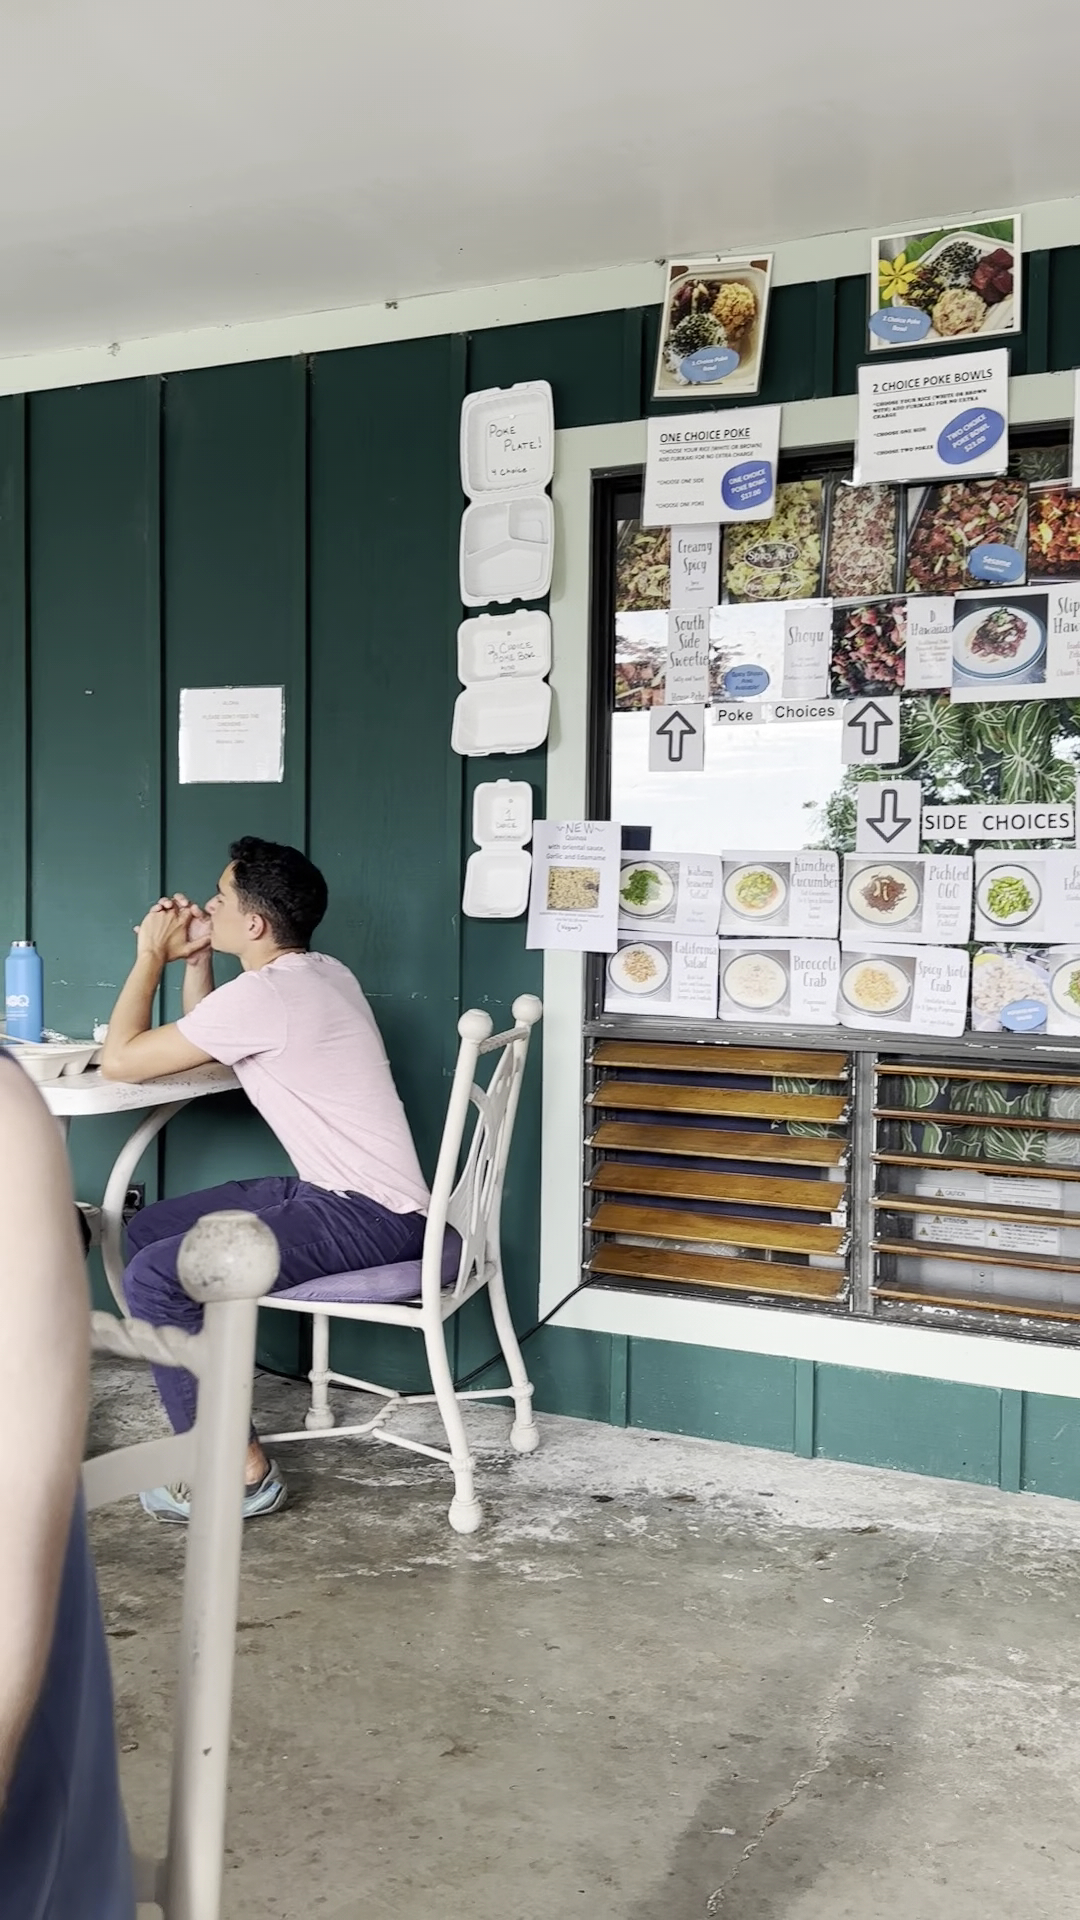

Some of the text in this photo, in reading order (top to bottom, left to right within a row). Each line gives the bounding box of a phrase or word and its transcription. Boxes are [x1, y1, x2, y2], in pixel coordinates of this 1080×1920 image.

[872, 368, 993, 393] 2 CHOICE POKE BOWLS
[660, 427, 751, 443] ONE CHOICE POKE
[946, 413, 987, 441] TWO CHOICE
[952, 434, 971, 449] POKE
[728, 468, 766, 485] ONE CHOICE
[730, 477, 767, 494] POKE BOWL
[678, 539, 713, 556] Creamy
[683, 557, 708, 575] Spicy
[674, 614, 704, 633] South
[679, 632, 700, 651] Side
[788, 626, 824, 648] Shoyu
[718, 704, 835, 722] Poke Choices
[565, 822, 595, 834] NEW
[924, 812, 1070, 831] SIDE CHOICES
[577, 853, 606, 861] Edamame
[929, 863, 970, 881] Pickled
[791, 873, 840, 889] Cucumber
[793, 955, 837, 971] Broccoli
[917, 960, 942, 979] Spicy
[803, 971, 827, 987] Crab
[930, 979, 952, 992] Crab
